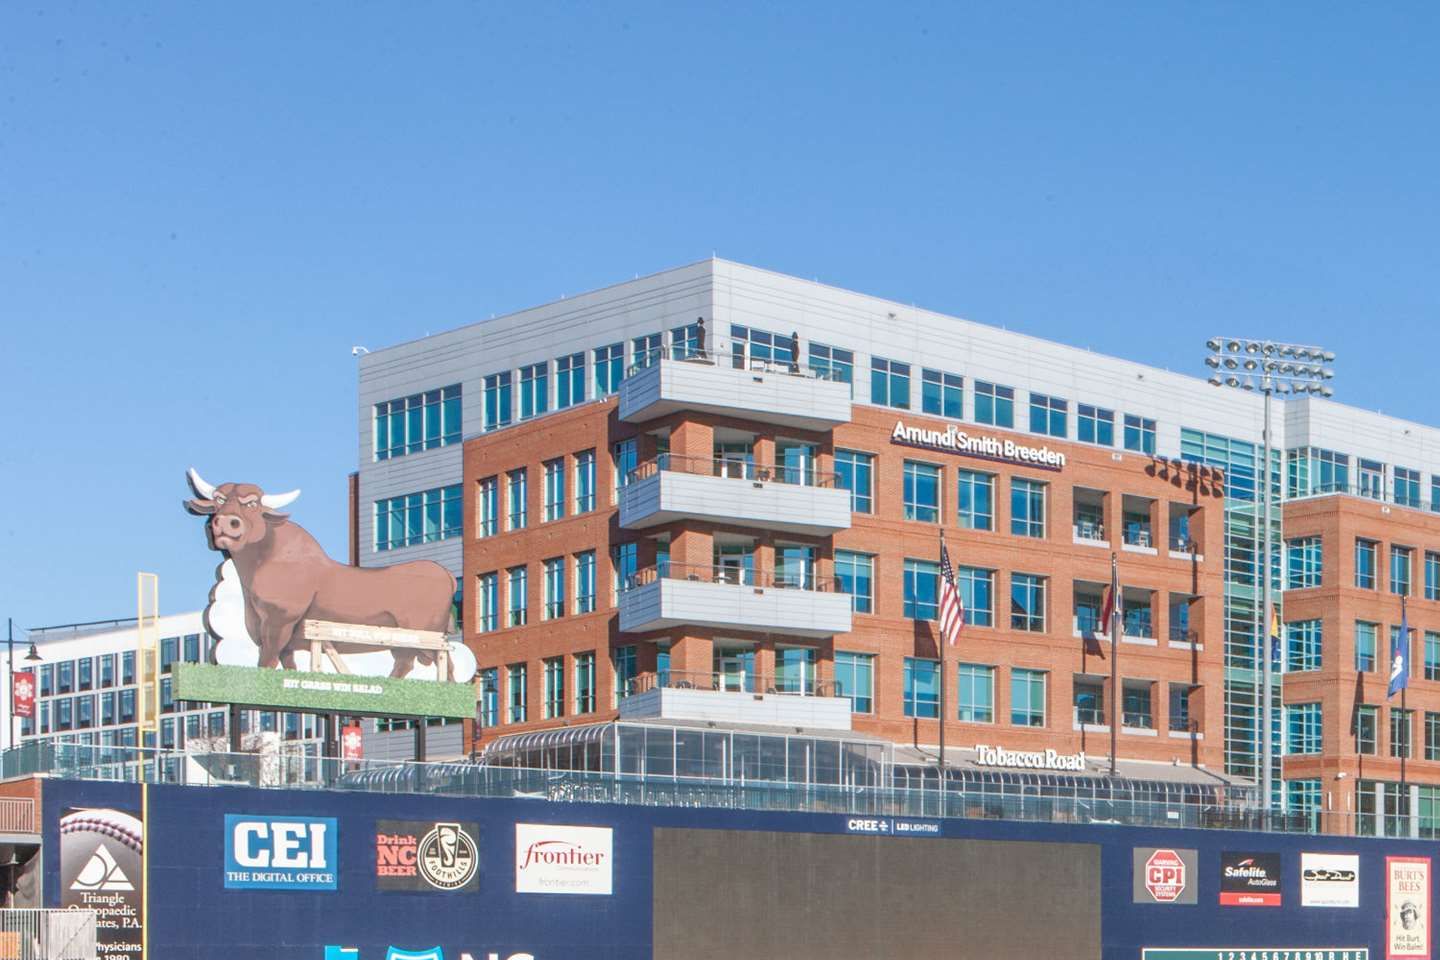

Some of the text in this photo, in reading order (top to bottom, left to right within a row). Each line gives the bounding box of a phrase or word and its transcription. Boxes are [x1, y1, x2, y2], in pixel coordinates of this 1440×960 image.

[893, 421, 1066, 466] Amundi Smith Breeden
[975, 744, 1085, 771] Tobacco Road
[848, 819, 939, 832] CREE LED LIGHTING
[234, 822, 327, 868] CEI
[377, 833, 417, 844] Drink
[377, 845, 417, 865] NC
[519, 840, 605, 869] frontier
[377, 865, 417, 876] BEER
[429, 860, 468, 880] FOOTHILLS
[1149, 867, 1182, 883] CPI
[1225, 866, 1266, 877] Safelite
[1394, 870, 1424, 880] BURT'S
[226, 872, 334, 883] THE DIGITAL OFFICE
[1399, 882, 1421, 891] BEES
[80, 892, 124, 906] Triangle
[122, 917, 142, 928] P.A.
